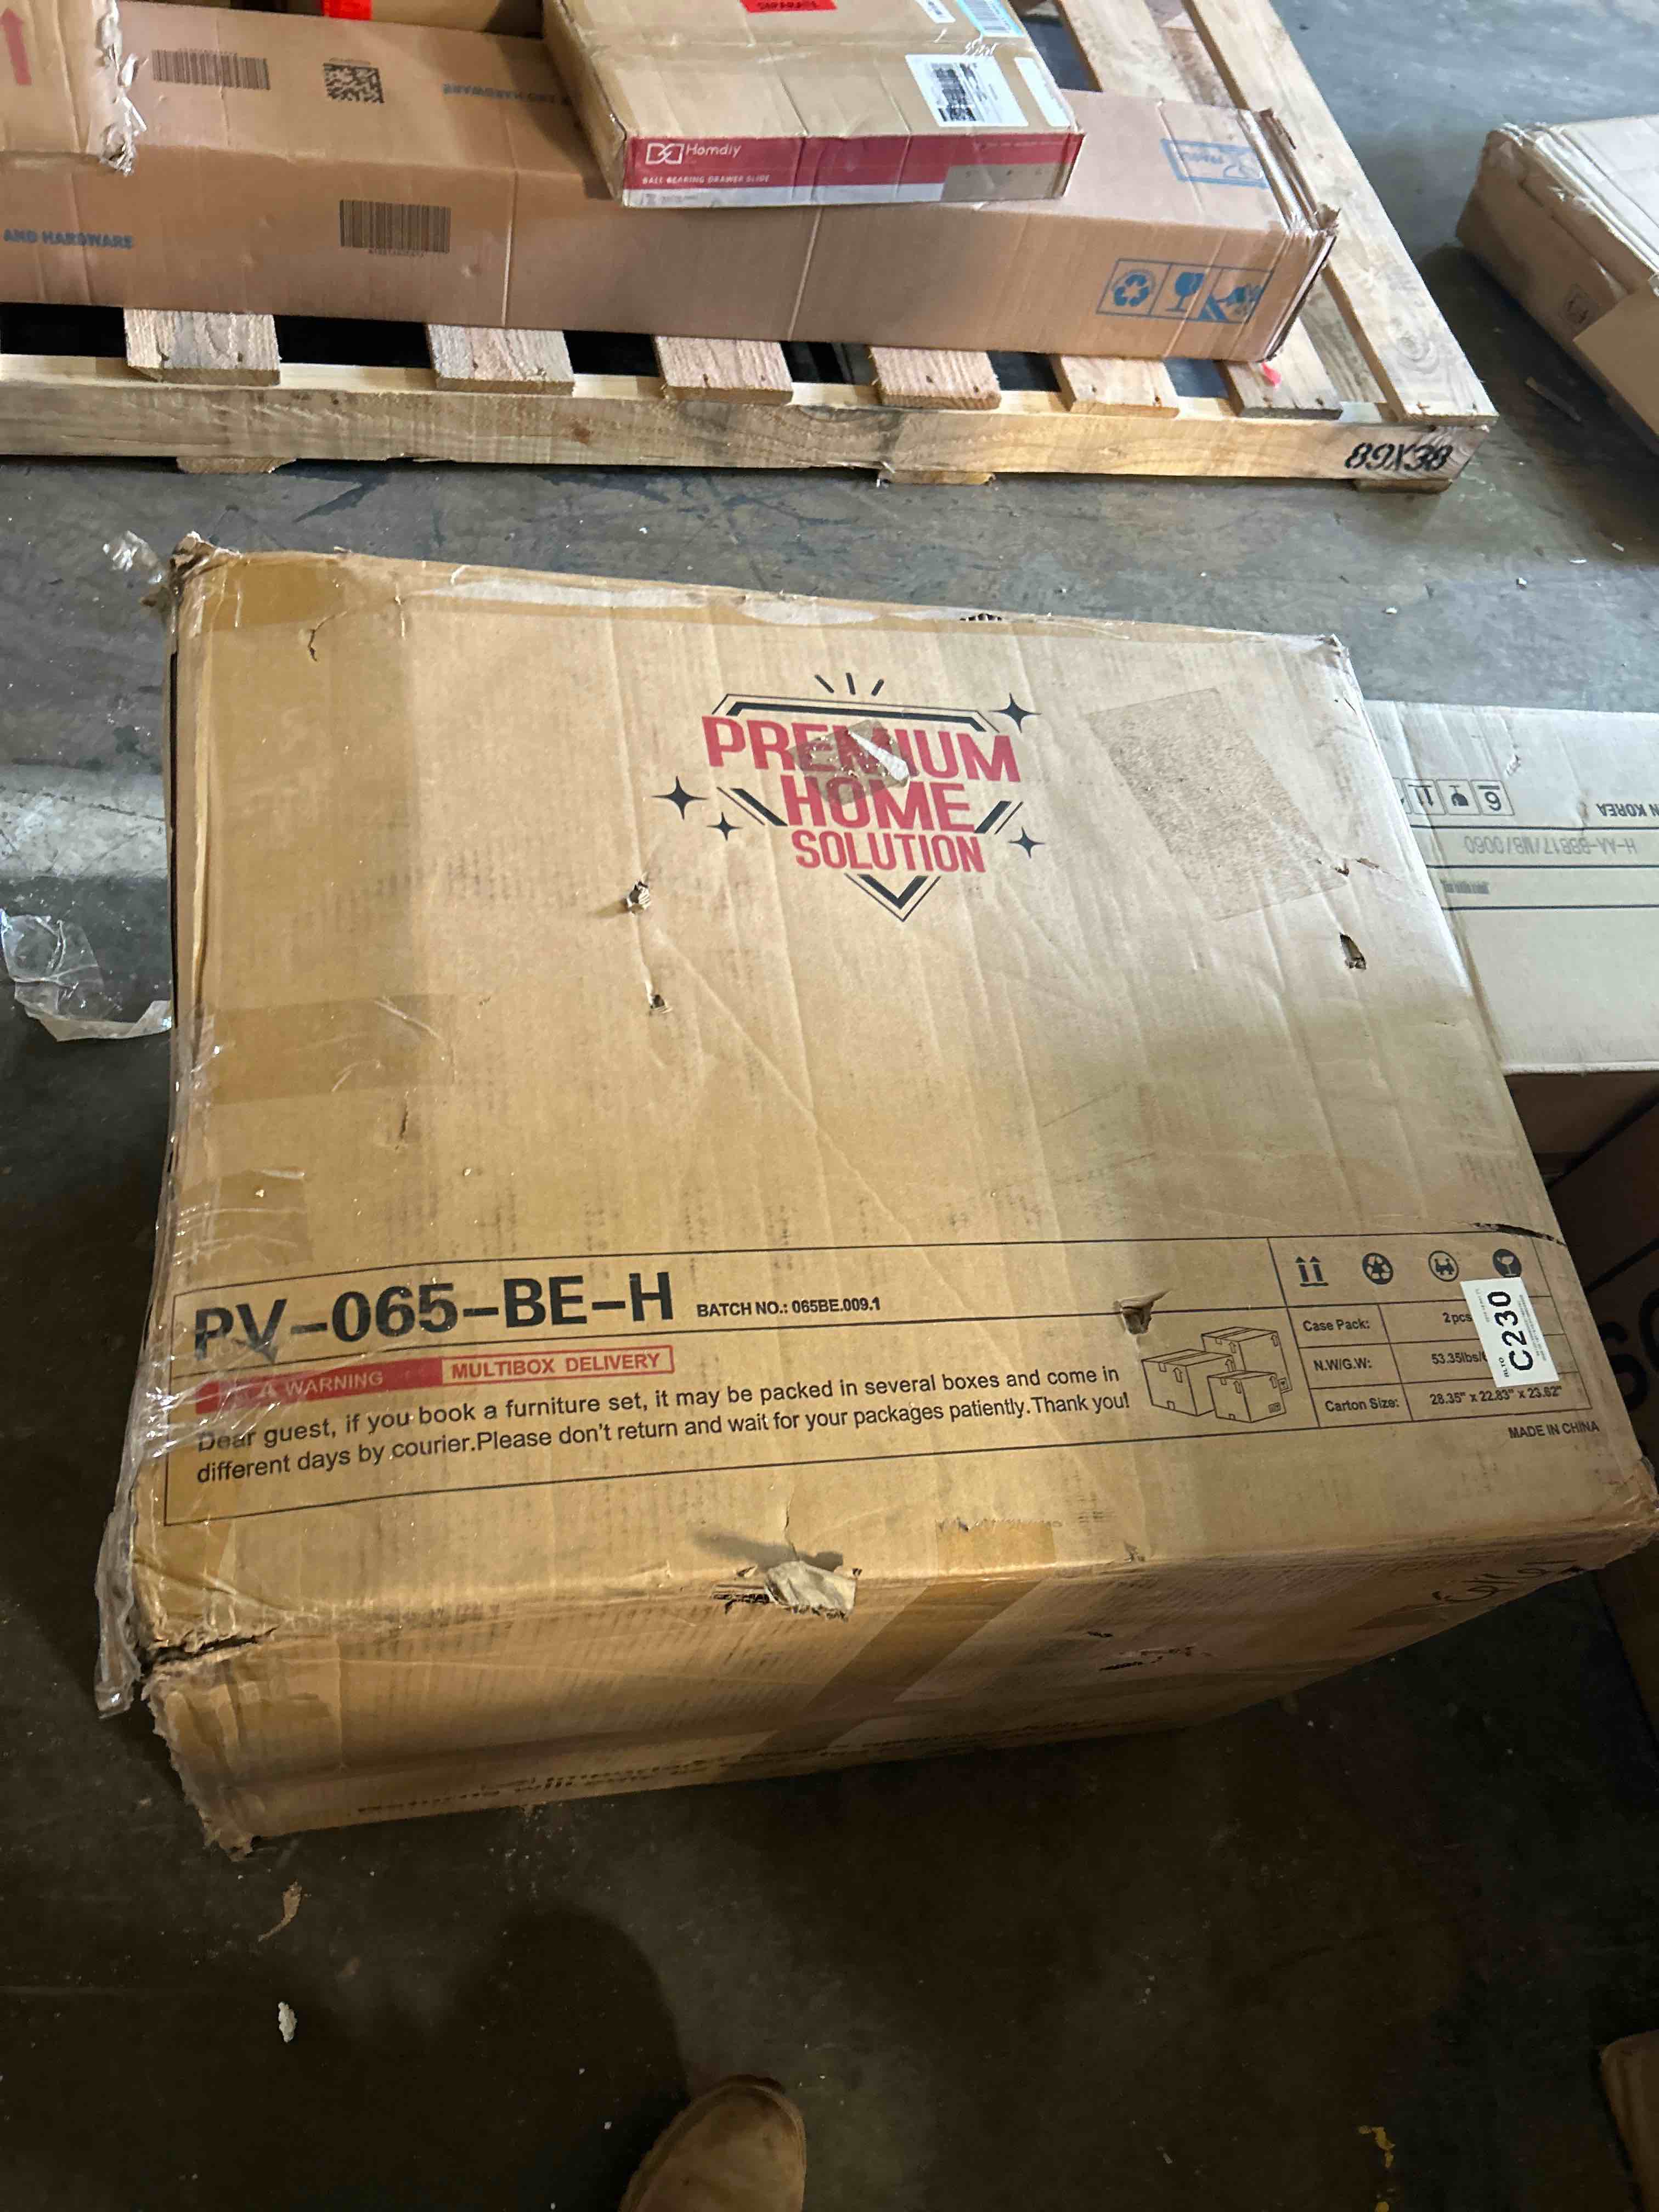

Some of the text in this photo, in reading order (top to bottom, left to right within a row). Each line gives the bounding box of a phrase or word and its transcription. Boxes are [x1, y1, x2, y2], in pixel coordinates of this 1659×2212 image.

[702, 715, 1020, 782] PREMIUM
[781, 775, 974, 833] HOME
[1595, 803, 1646, 816] KOREA
[791, 830, 986, 872] SOLUTION
[697, 1297, 880, 1318] BATCH NO.: 065BE.009.1
[1302, 1321, 1333, 1333] Case
[1336, 1319, 1370, 1331] Pack:
[1489, 1290, 1534, 1372] C230
[452, 1353, 661, 1380] MULTIBOX DELIVERY
[1313, 1358, 1372, 1372] N.W/G.W:
[284, 1371, 383, 1397] WARNING
[263, 1420, 337, 1448] guest,
[346, 1414, 360, 1434] if
[368, 1414, 409, 1435] you
[419, 1403, 475, 1425] book
[483, 1406, 496, 1420] a
[506, 1393, 600, 1417] furniture
[608, 1392, 647, 1413] set,
[654, 1390, 669, 1408] it
[676, 1389, 720, 1409] may
[727, 1384, 752, 1404] be
[761, 1380, 832, 1402] packed
[840, 1378, 857, 1396] in
[865, 1373, 935, 1395] several
[943, 1370, 998, 1390] boxes
[1006, 1368, 1040, 1386] and
[1047, 1368, 1097, 1384] come
[1103, 1365, 1120, 1383] in
[1324, 1386, 1562, 1412] Carton Size: 28.35" x 22.83" x 23.62"
[197, 1392, 1130, 1483] different days by courier.Please don't return and wait for your packages patiently.Thank you!
[1508, 1421, 1600, 1439] MADE IN CHINA
